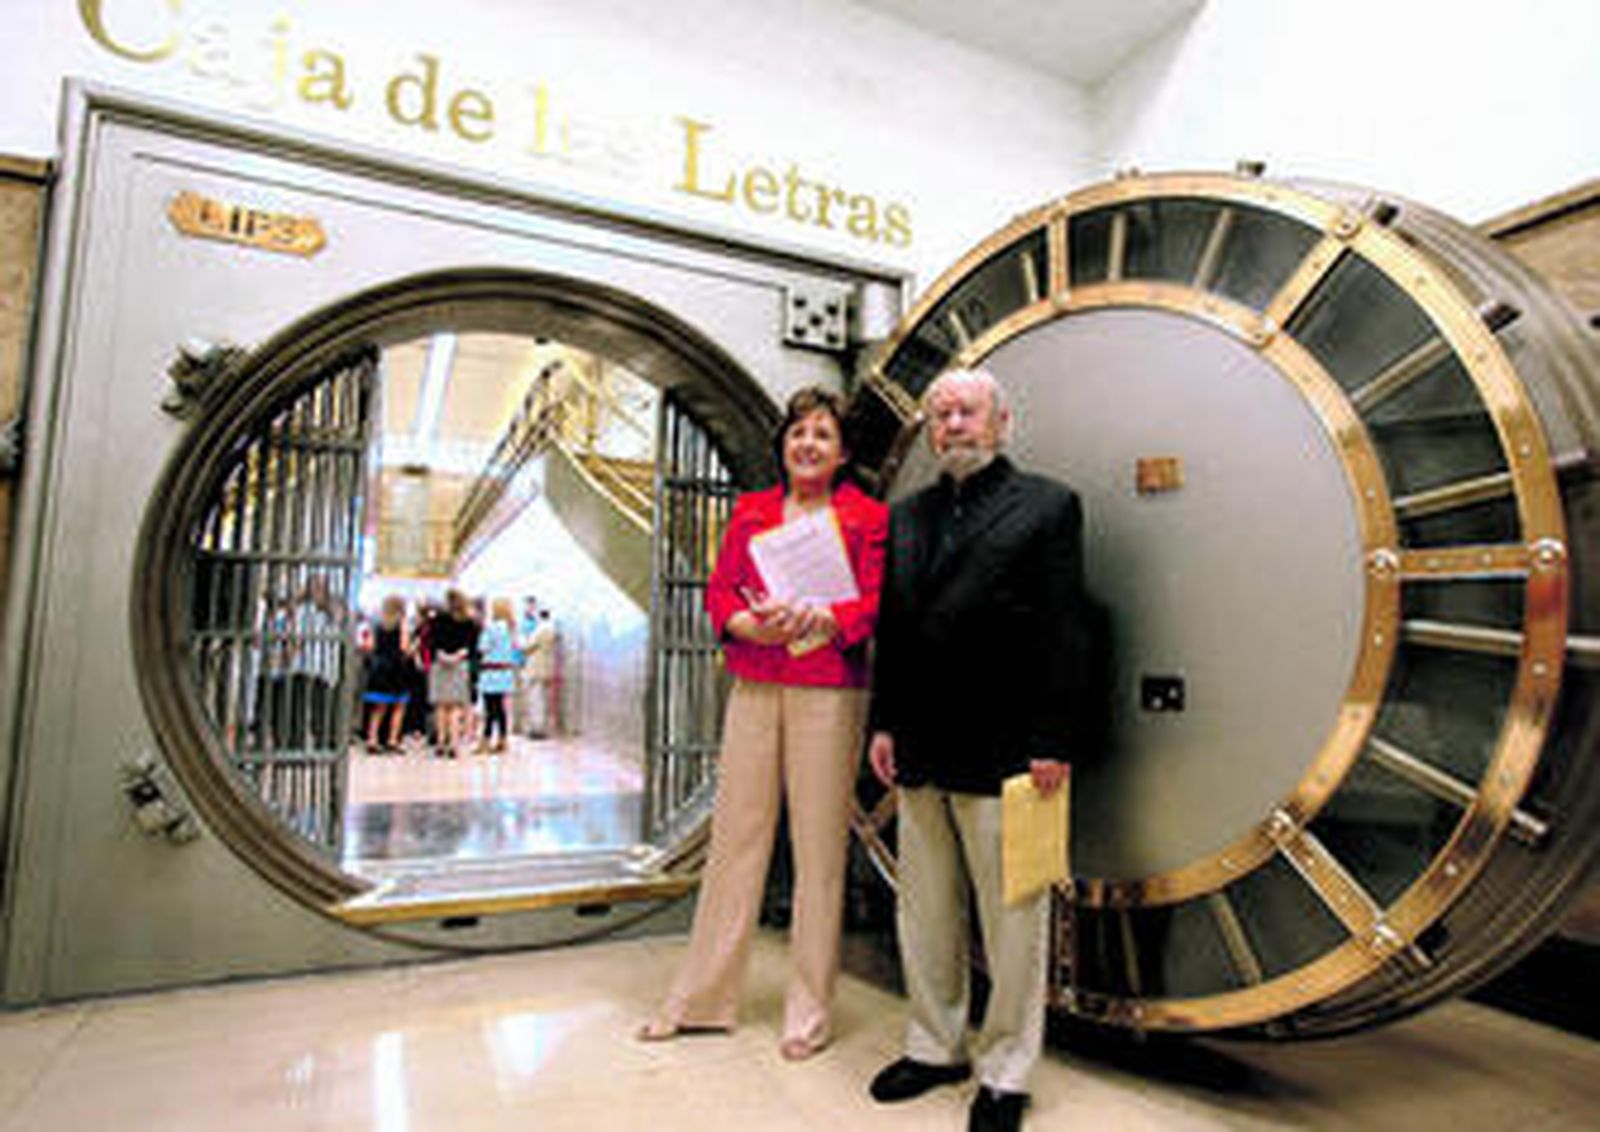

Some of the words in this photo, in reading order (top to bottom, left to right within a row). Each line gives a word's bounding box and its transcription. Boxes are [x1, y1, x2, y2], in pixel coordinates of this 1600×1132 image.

[386, 52, 496, 142] de
[525, 78, 644, 184] ls
[671, 115, 914, 248] Letras
